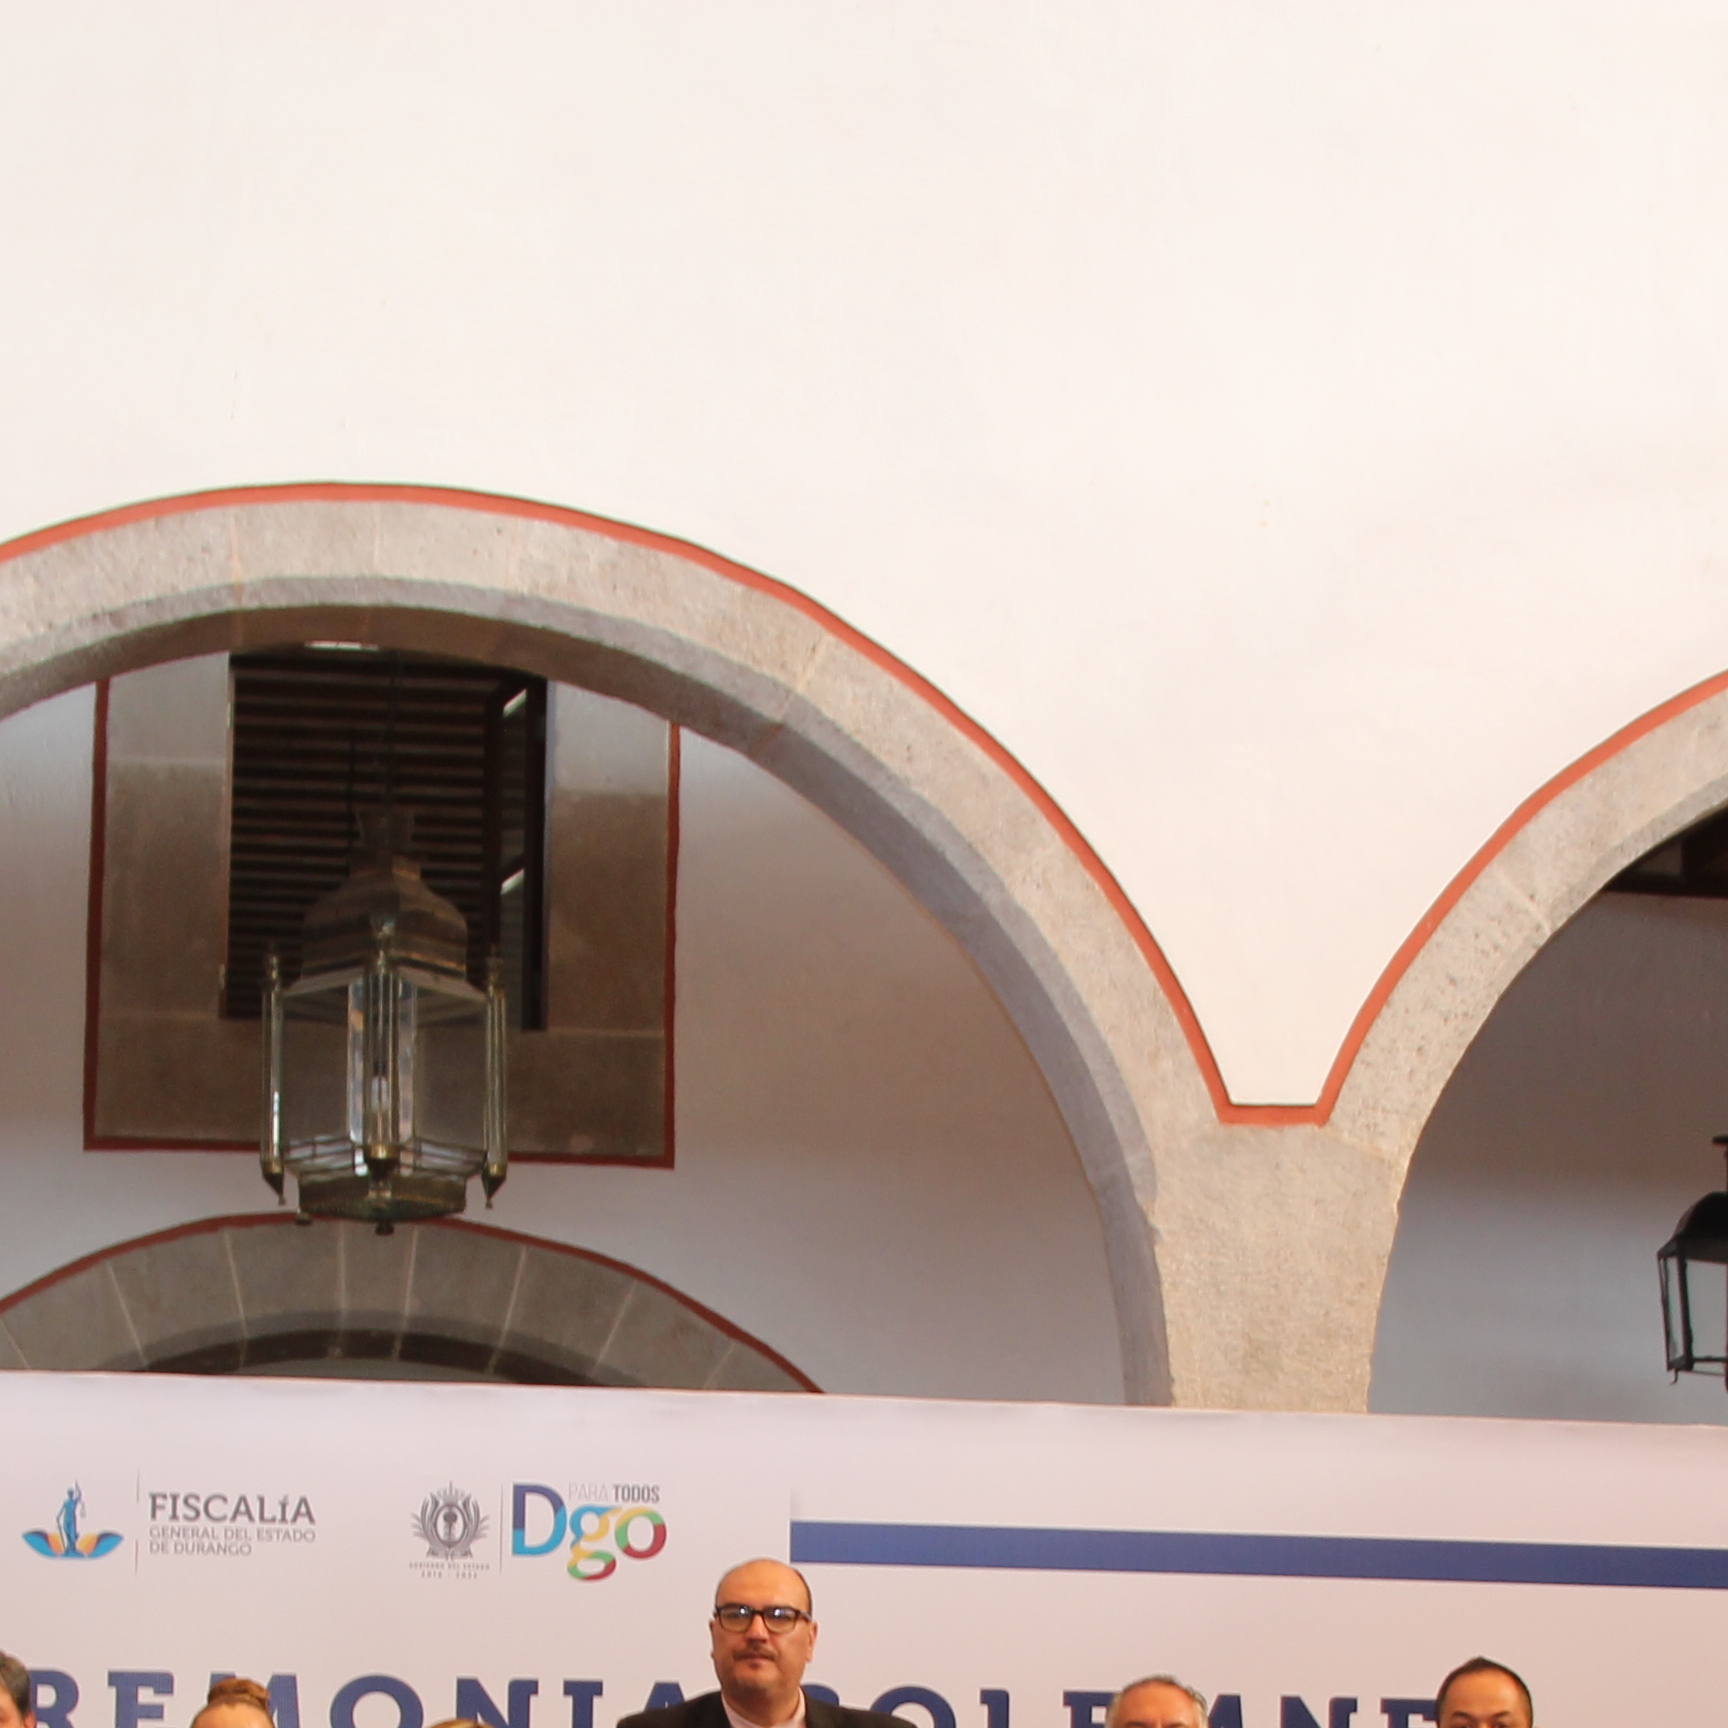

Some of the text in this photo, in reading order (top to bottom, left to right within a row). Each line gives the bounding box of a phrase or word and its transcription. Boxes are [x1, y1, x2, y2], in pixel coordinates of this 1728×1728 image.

[570, 1483, 660, 1503] PARA TODOS
[148, 1492, 316, 1525] FISCALÍA
[149, 1527, 316, 1543] GENERAL DEL ESTADO
[512, 1482, 667, 1582] Dgo
[149, 1541, 253, 1556] DE DURANGO
